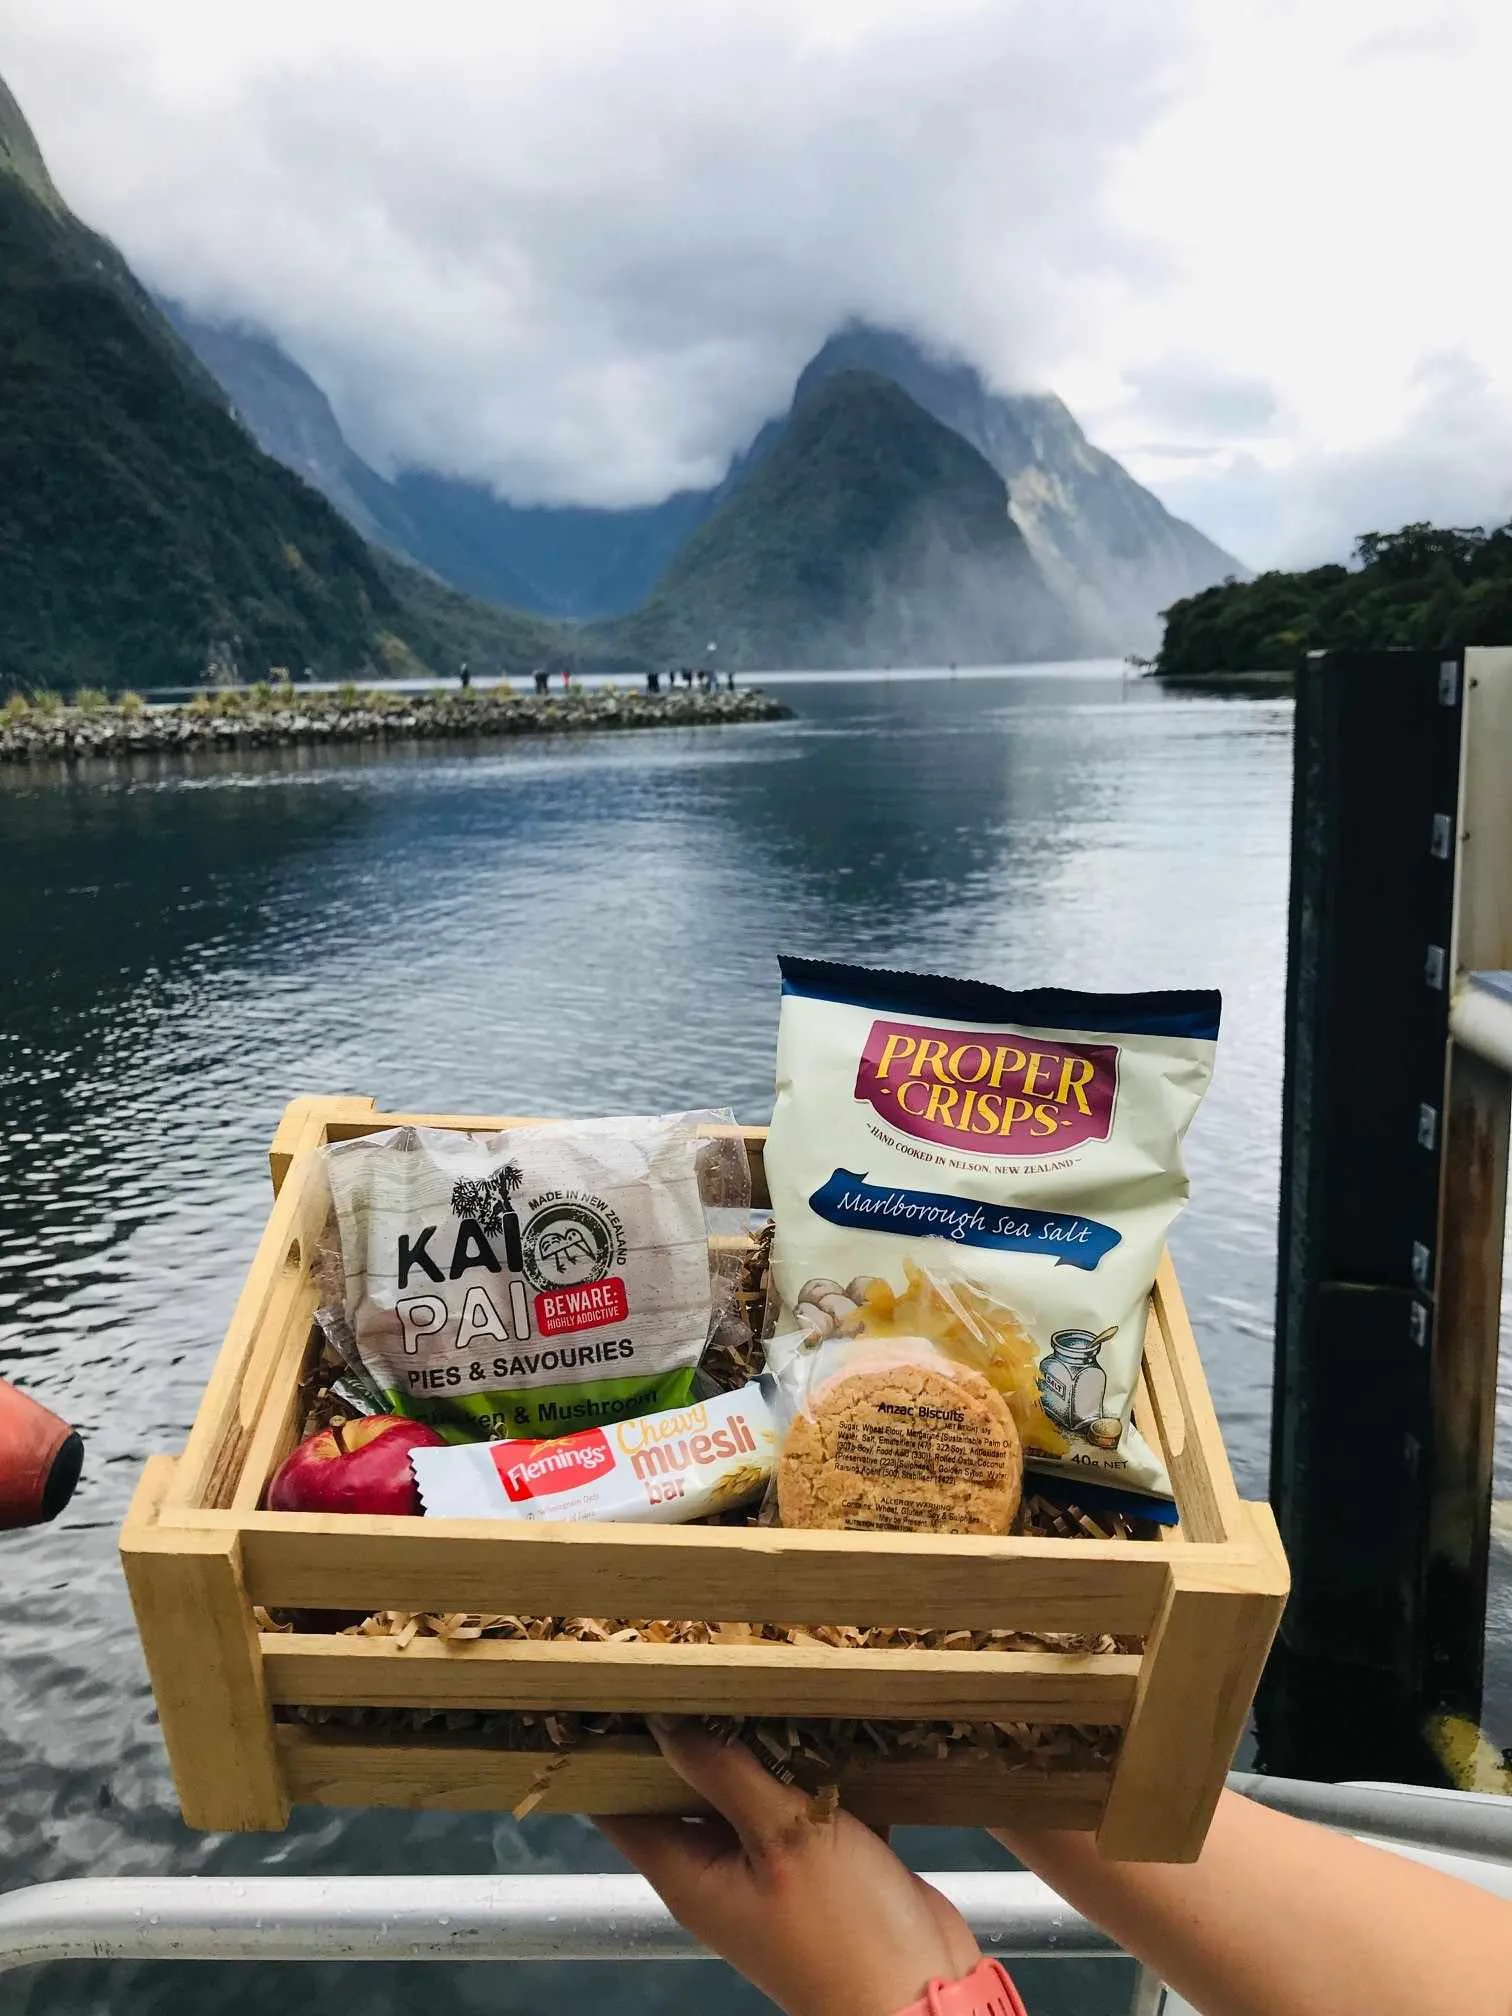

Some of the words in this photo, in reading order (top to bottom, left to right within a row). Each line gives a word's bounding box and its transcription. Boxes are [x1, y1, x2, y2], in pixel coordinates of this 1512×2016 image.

[875, 1033, 1098, 1116] PROPER
[896, 1080, 1061, 1137] CRISPS
[870, 1124, 896, 1151] HAND
[895, 1140, 933, 1164] COOKED
[934, 1154, 947, 1166] IN
[994, 1163, 1021, 1175] NEW
[1023, 1158, 1075, 1175] ZEALAND
[528, 1190, 563, 1211] MADE
[566, 1189, 578, 1200] IN
[580, 1193, 608, 1211] NEW
[605, 1209, 627, 1266] ZEALAND
[837, 1191, 985, 1238] Marlborough
[397, 1210, 524, 1290] KAI
[394, 1280, 530, 1356] PAI
[543, 1285, 619, 1319] BEWARE:
[546, 1314, 576, 1331] HIGHLY
[577, 1305, 620, 1326] ADDICTIVE
[408, 1362, 461, 1390] PIES
[469, 1361, 487, 1379] &
[493, 1339, 634, 1376] SAVOURIES
[1045, 1375, 1064, 1394] SALT
[513, 1406, 530, 1424] &
[538, 1388, 658, 1422] Mushroom
[877, 1402, 914, 1416] Anzac
[919, 1406, 965, 1422] Biscuits
[615, 1405, 710, 1455] Chewy
[630, 1415, 757, 1480] muesli
[839, 1420, 860, 1432] Sugar,
[984, 1438, 1001, 1448] Palm
[505, 1443, 606, 1492] Flemings
[876, 1446, 893, 1456] Food
[934, 1453, 956, 1464] Rolled
[977, 1459, 1005, 1469] Coconut
[938, 1465, 963, 1475] Golden
[1103, 1460, 1128, 1470] NET
[643, 1475, 686, 1506] bar
[880, 1497, 915, 1508] ALLERGY
[916, 1501, 952, 1512] WARNING
